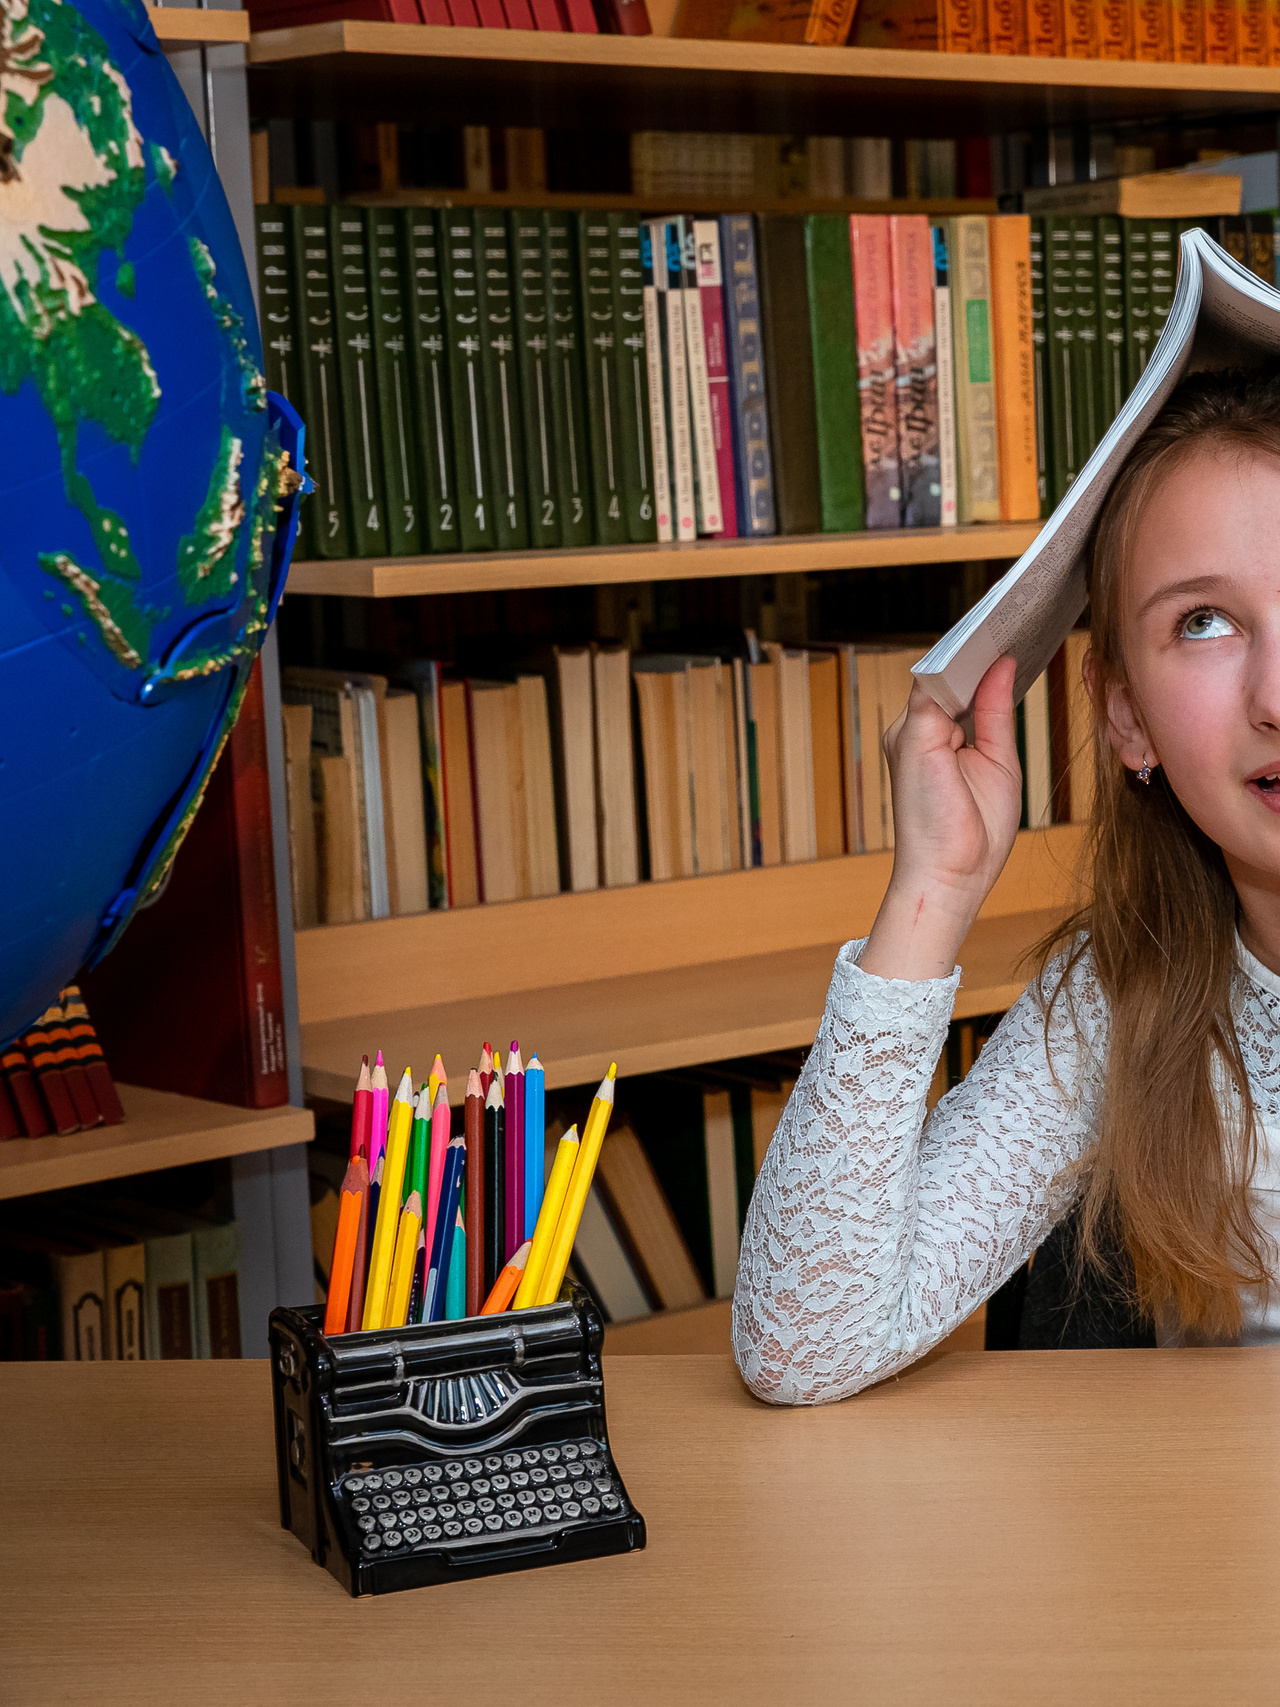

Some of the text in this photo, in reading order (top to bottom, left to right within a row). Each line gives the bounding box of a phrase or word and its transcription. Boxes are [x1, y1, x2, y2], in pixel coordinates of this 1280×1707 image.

[367, 504, 380, 531] 4
[405, 505, 415, 532] 3
[440, 504, 453, 531] 2
[475, 504, 486, 531] 1
[507, 502, 516, 528] 1
[541, 501, 554, 525] 2
[572, 498, 584, 523] 3
[608, 495, 619, 519] 4
[639, 495, 652, 520] 6
[328, 511, 340, 538] 5
